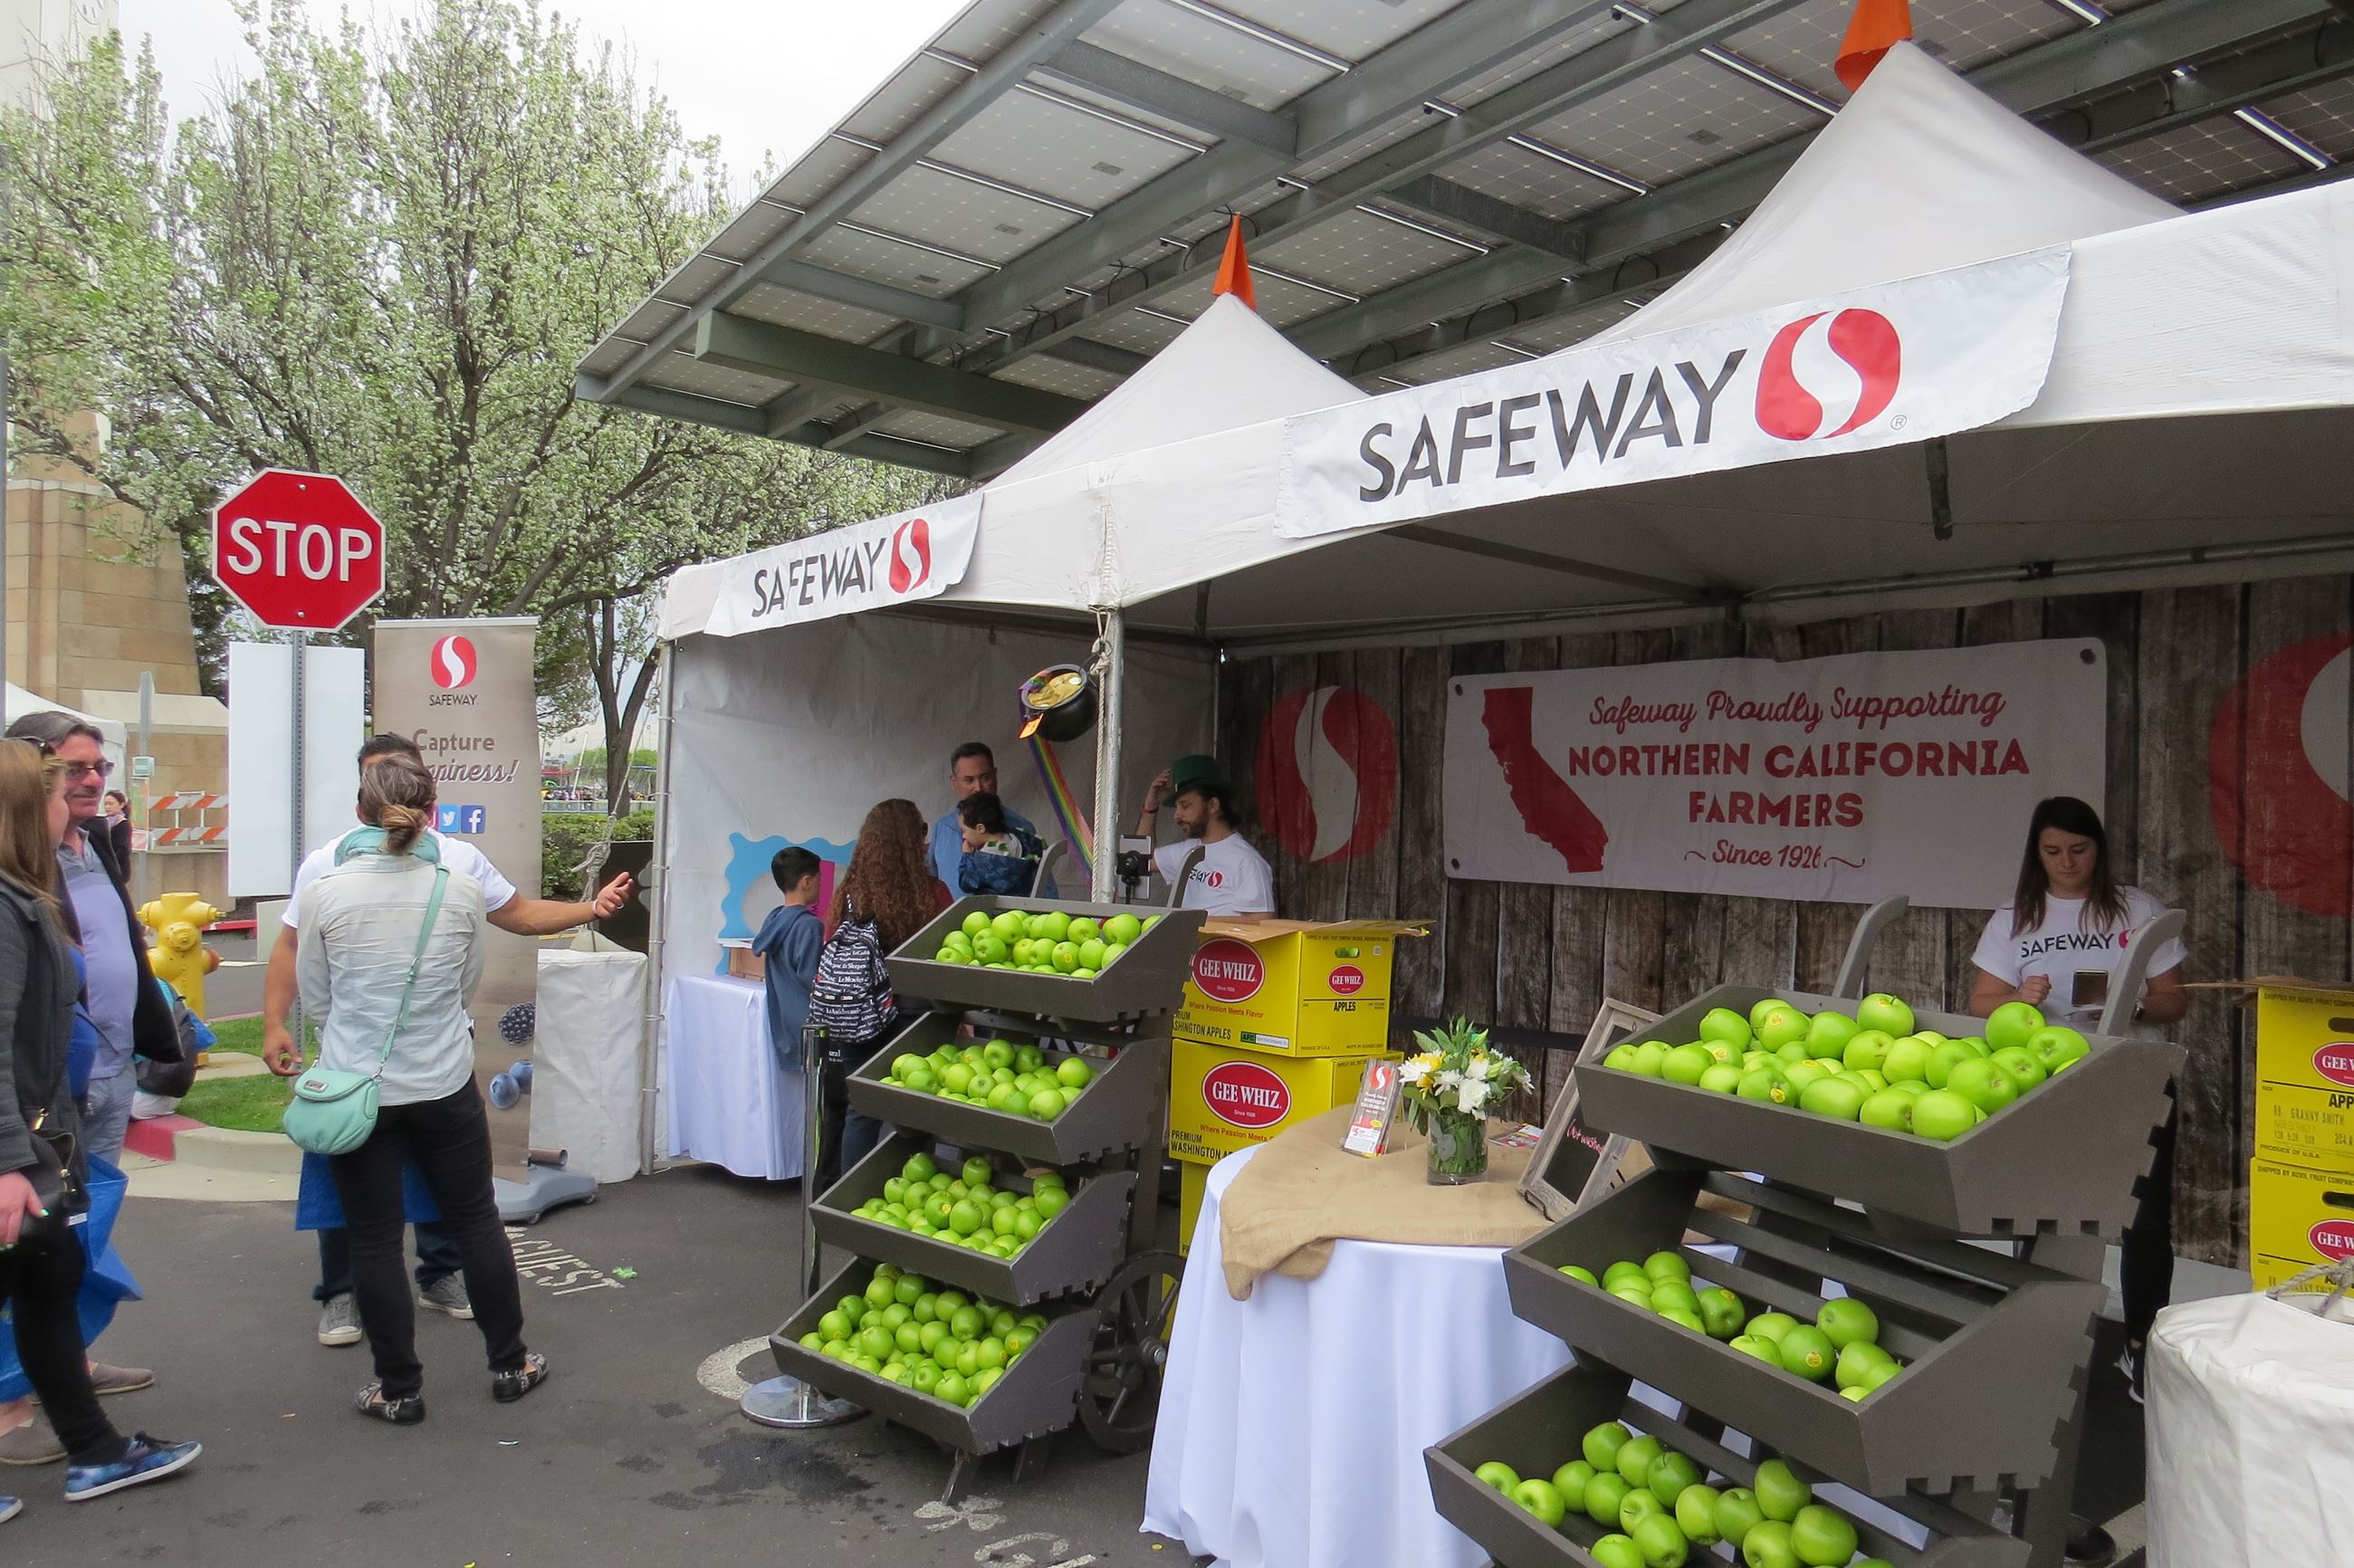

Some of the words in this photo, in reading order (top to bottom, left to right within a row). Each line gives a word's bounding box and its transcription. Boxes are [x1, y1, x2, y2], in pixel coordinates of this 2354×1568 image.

[1360, 349, 1747, 502] SAFEWAY
[227, 517, 373, 582] STOP
[751, 537, 887, 618] SAFEWAY
[429, 694, 478, 706] SAFEWAY
[1590, 695, 1698, 734] Safeway
[1707, 690, 1823, 734] Proudly
[1831, 684, 2006, 731] Supporting
[413, 729, 495, 757] Capture
[1569, 742, 1750, 777] NORTHERN
[1765, 738, 2031, 778] CALIFORNIA
[1689, 791, 1864, 827] FARMERS
[1712, 839, 1773, 865] Since
[2021, 933, 2114, 958] SAFEWAY
[1199, 958, 1220, 978] GEE
[1222, 961, 1256, 982] WHIZ
[1332, 975, 1344, 985] GEE
[1344, 975, 1362, 985] WHIZ
[1206, 1004, 1227, 1013] Passion
[1228, 1007, 1245, 1016] Meets
[1246, 1009, 1264, 1018] Flavor
[1334, 1001, 1356, 1012] APPLES
[1207, 1026, 1231, 1039] APPLES
[2321, 1055, 2349, 1070] GEE
[1212, 1081, 1238, 1103] GEE
[1239, 1085, 1281, 1109] WHIZ
[1172, 1130, 1202, 1143] PREMIUM
[1201, 1124, 1220, 1134] Where
[1221, 1128, 1246, 1139] Passion
[1249, 1133, 1268, 1143] Meets
[1172, 1142, 1220, 1160] WASHINGTON
[2260, 1144, 2290, 1155] PRODUCE
[2292, 1148, 2301, 1156] OF
[2317, 1231, 2342, 1248] GEE
